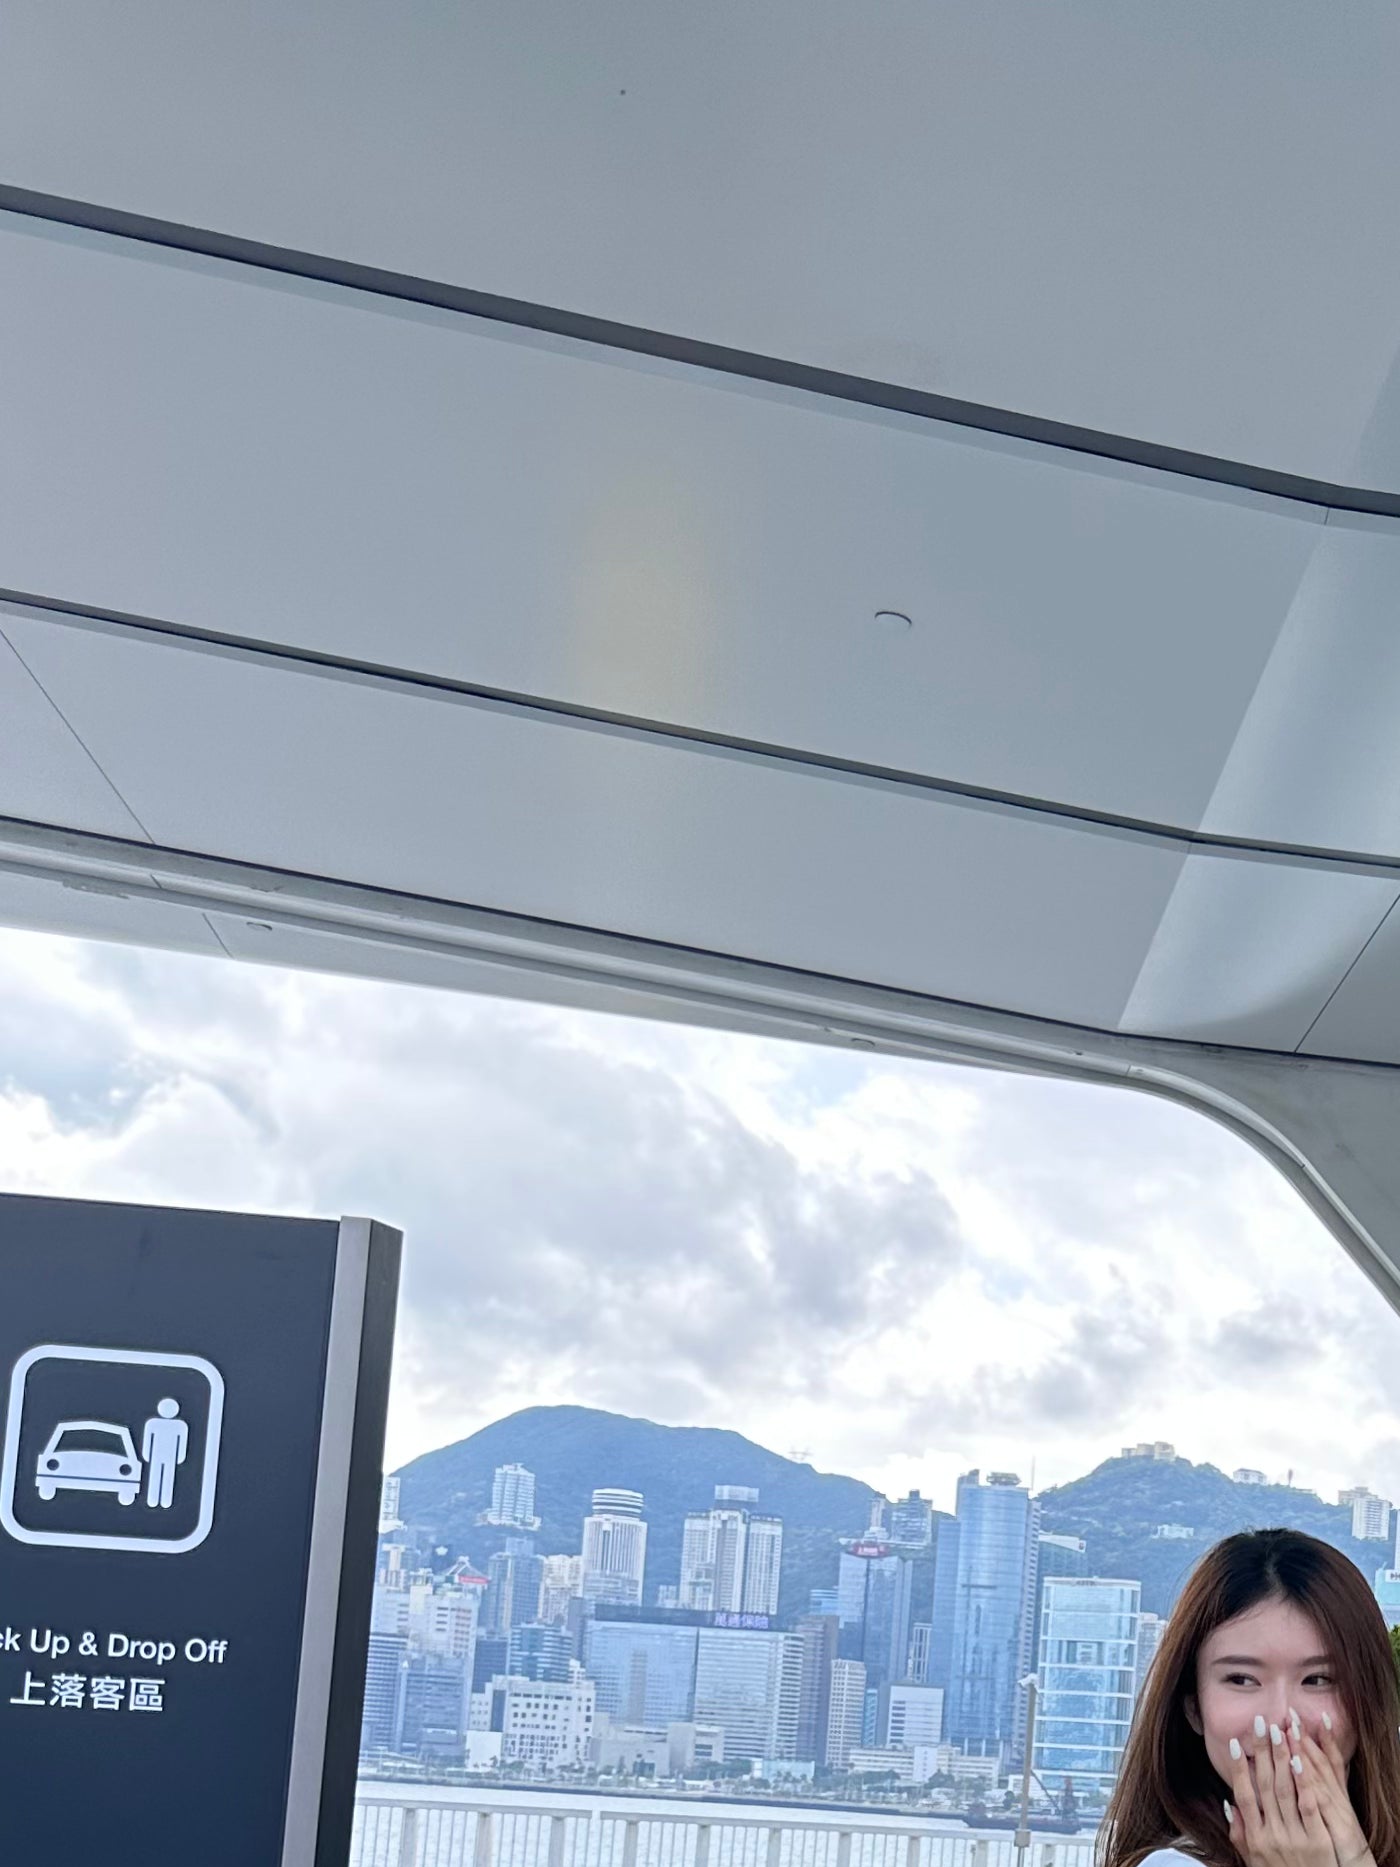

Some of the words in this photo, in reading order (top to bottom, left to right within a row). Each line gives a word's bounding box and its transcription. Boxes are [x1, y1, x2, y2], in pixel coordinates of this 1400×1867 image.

[30, 1628, 71, 1659] Up
[79, 1631, 98, 1656] &
[107, 1633, 176, 1665] Drop
[184, 1637, 228, 1664] Off
[9, 1670, 166, 1712] 上落客區
